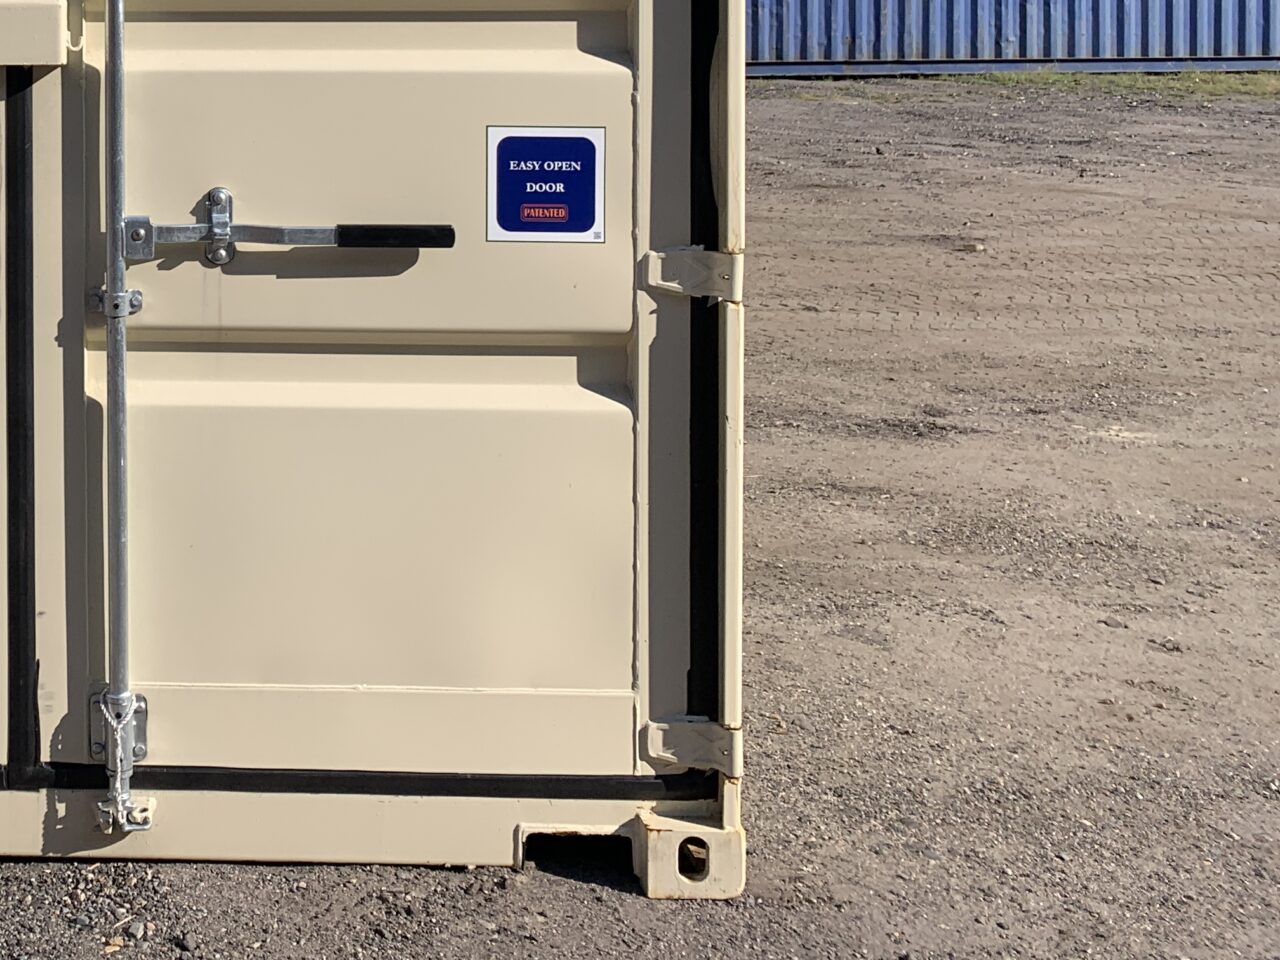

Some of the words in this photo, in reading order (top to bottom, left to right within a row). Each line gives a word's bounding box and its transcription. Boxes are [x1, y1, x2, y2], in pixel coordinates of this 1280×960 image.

[509, 160, 542, 171] EASY
[544, 161, 581, 171] OPEN
[526, 182, 565, 192] DOOR
[524, 208, 565, 217] PATENTED
